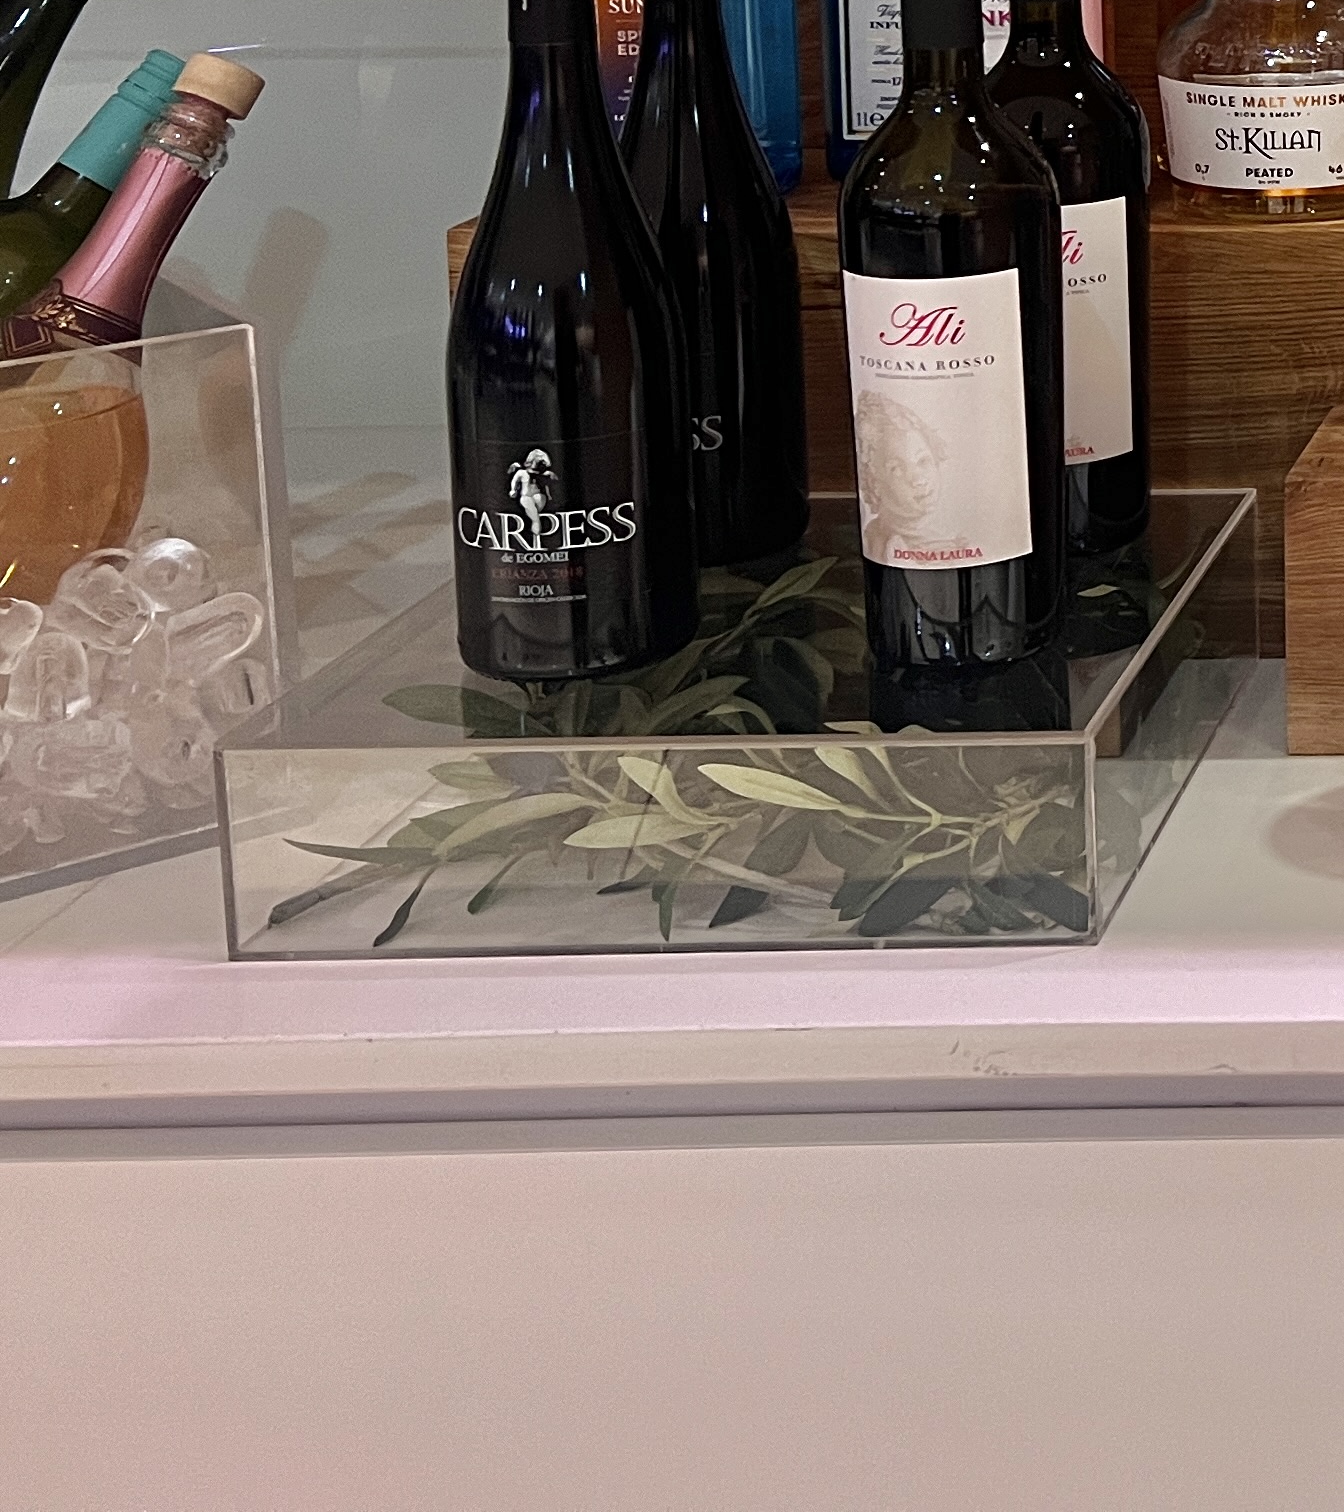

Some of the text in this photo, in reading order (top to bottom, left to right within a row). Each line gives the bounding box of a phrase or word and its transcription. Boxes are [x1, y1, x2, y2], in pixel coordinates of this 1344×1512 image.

[1185, 91, 1236, 107] SINGLE
[1242, 96, 1286, 108] MALT
[1245, 167, 1294, 178] PEATED
[879, 303, 966, 347] Ali
[859, 354, 995, 371] TOSCANA ROSSO
[457, 501, 638, 552] CARPESS
[515, 550, 570, 564] EGOMEI
[893, 546, 984, 561] DONNA LAURA
[518, 585, 554, 597] RIOJA
